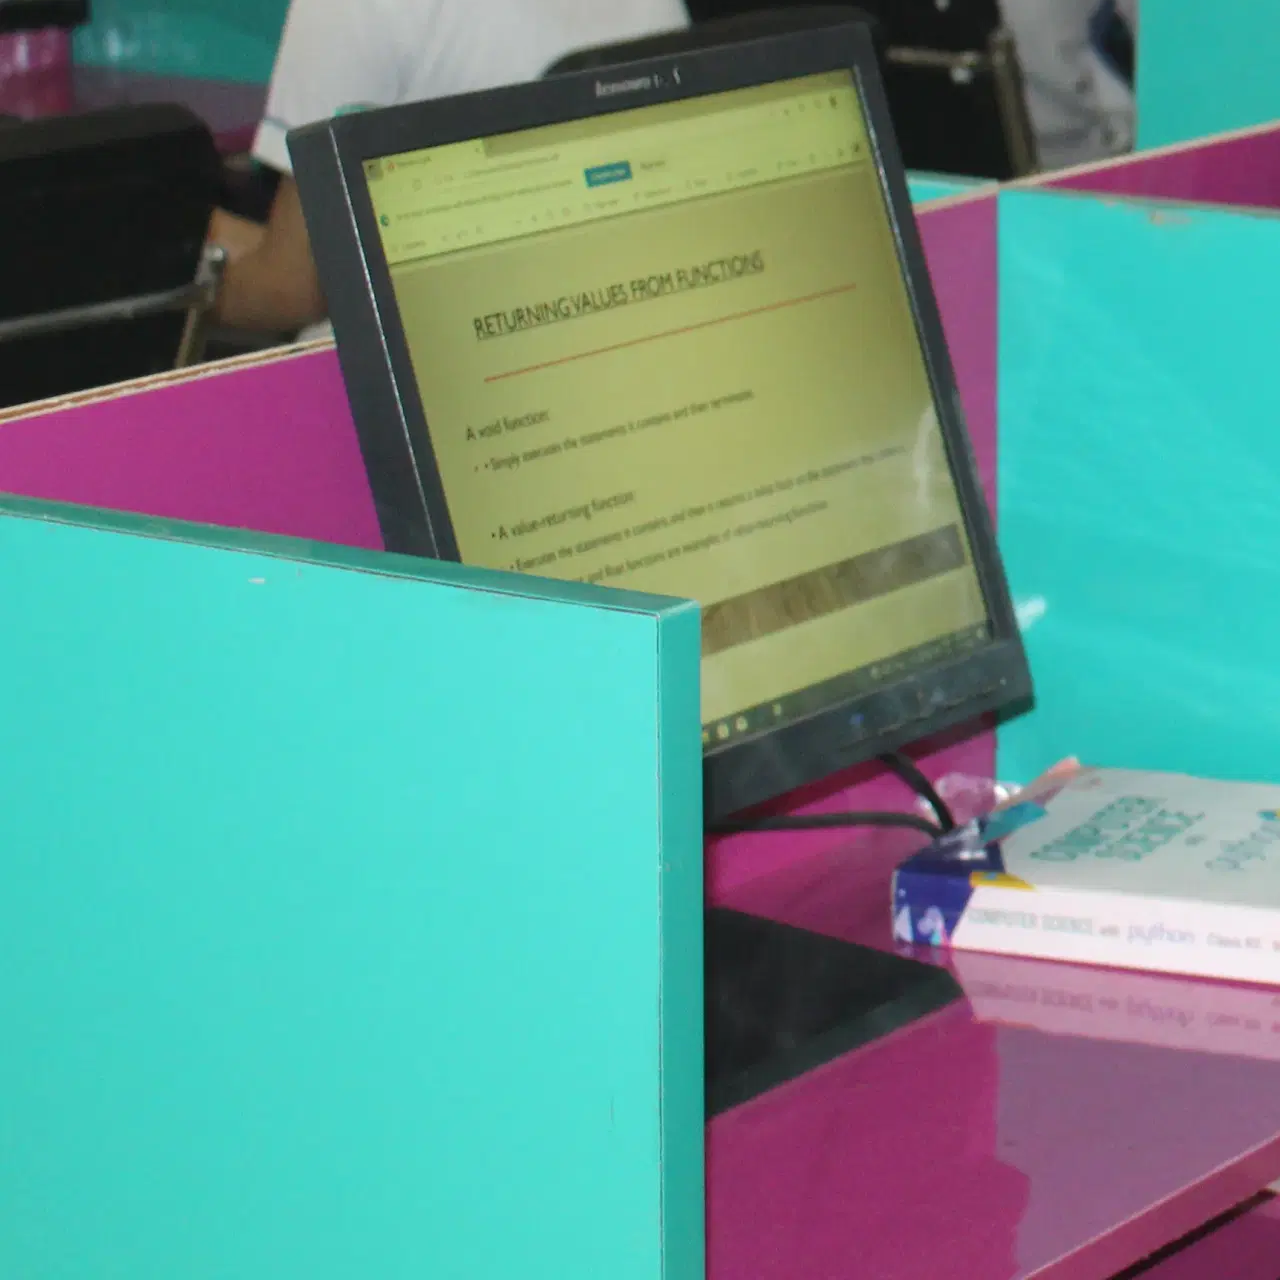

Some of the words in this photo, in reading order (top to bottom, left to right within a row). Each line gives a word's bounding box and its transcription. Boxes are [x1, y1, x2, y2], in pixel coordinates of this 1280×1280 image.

[471, 294, 571, 340] RETURNING
[568, 281, 629, 316] VALUES
[627, 269, 676, 301] FROM
[674, 247, 765, 291] FUNCTIONS
[462, 423, 477, 442] A
